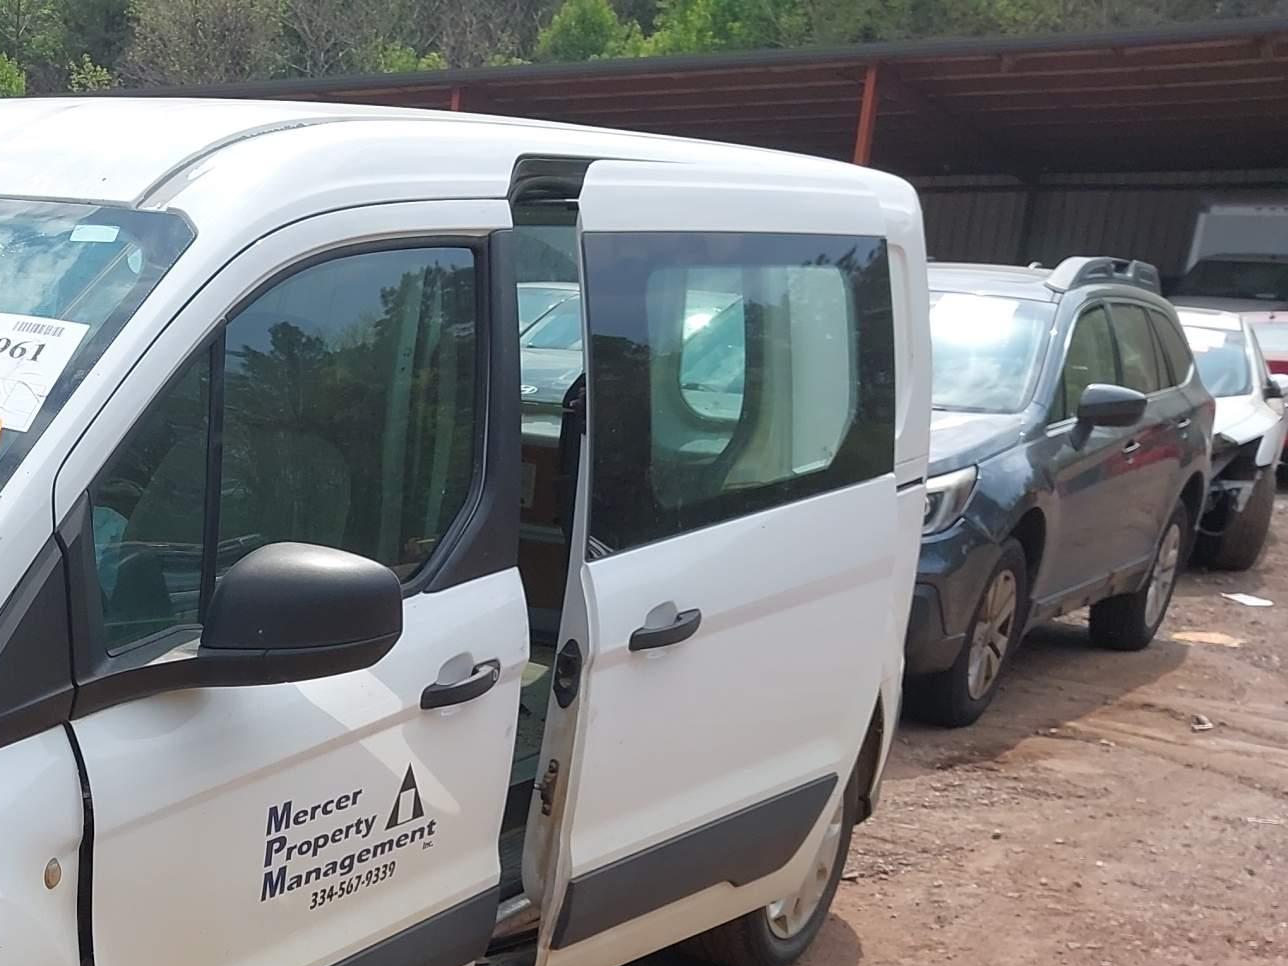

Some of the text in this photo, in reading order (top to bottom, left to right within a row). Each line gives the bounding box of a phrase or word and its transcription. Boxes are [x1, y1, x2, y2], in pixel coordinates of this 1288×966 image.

[266, 789, 363, 836] Mercer
[261, 819, 437, 902] Management
[264, 814, 378, 868] Property
[309, 860, 396, 911] 334-567-9339
